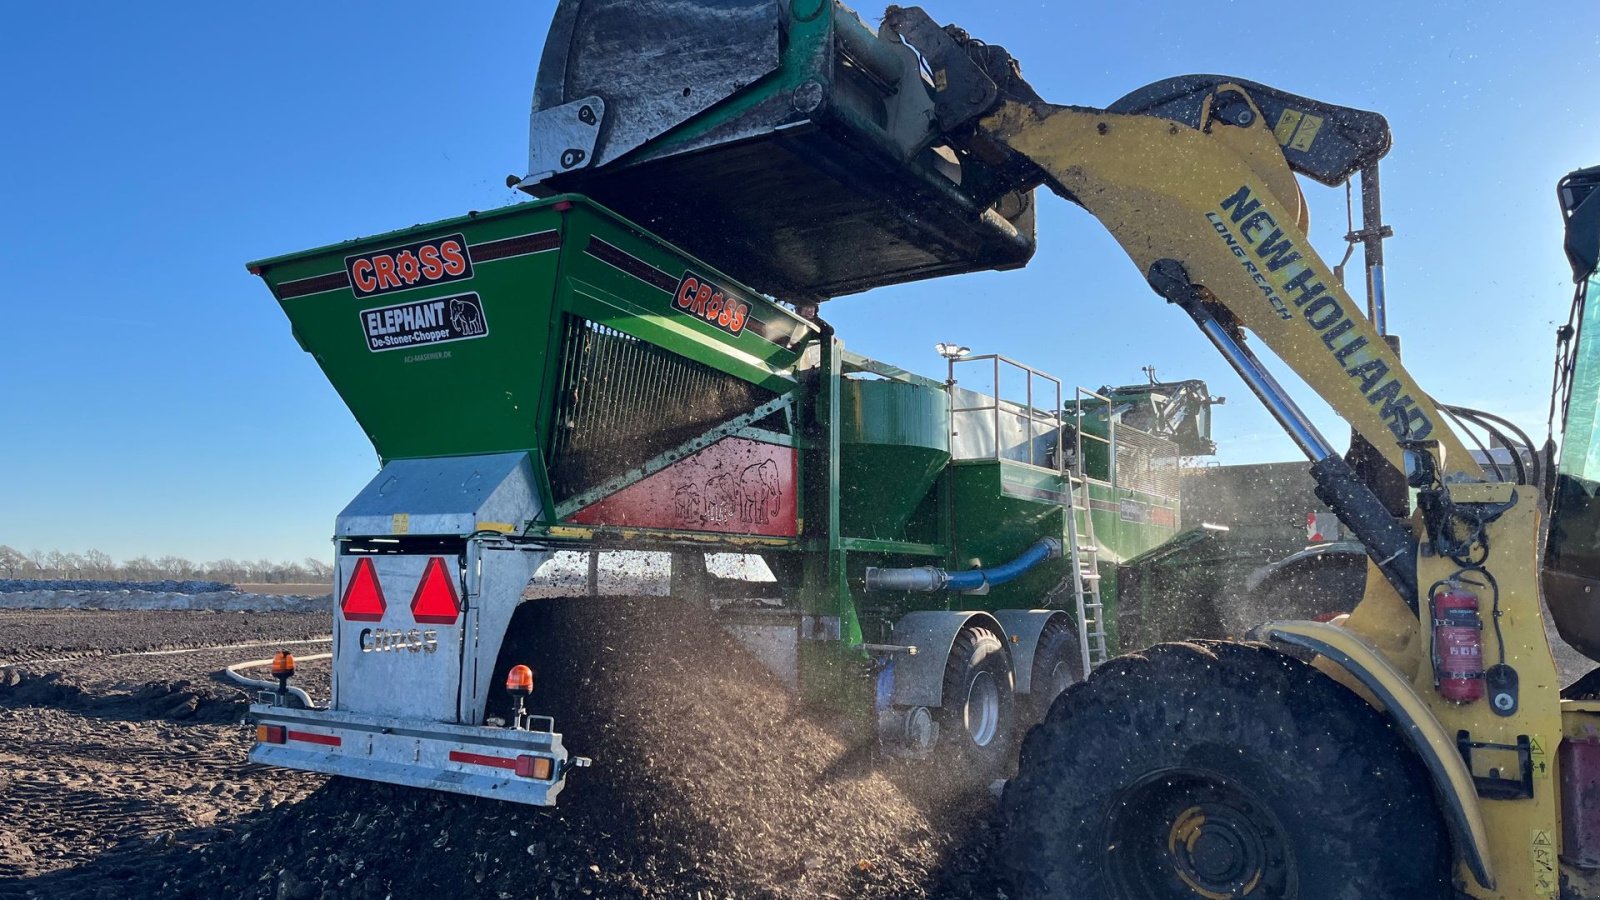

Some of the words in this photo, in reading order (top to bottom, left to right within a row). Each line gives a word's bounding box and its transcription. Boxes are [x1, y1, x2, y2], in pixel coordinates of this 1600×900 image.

[352, 240, 466, 293] CROSS
[1204, 211, 1246, 258] LONG
[1241, 257, 1294, 321] REACH
[366, 301, 445, 337] ELEPHANT
[677, 277, 748, 332] CROSS
[1219, 185, 1303, 273] NEW
[1282, 267, 1434, 442] HOLLAND
[371, 328, 450, 348] De-Stoner-Chopper
